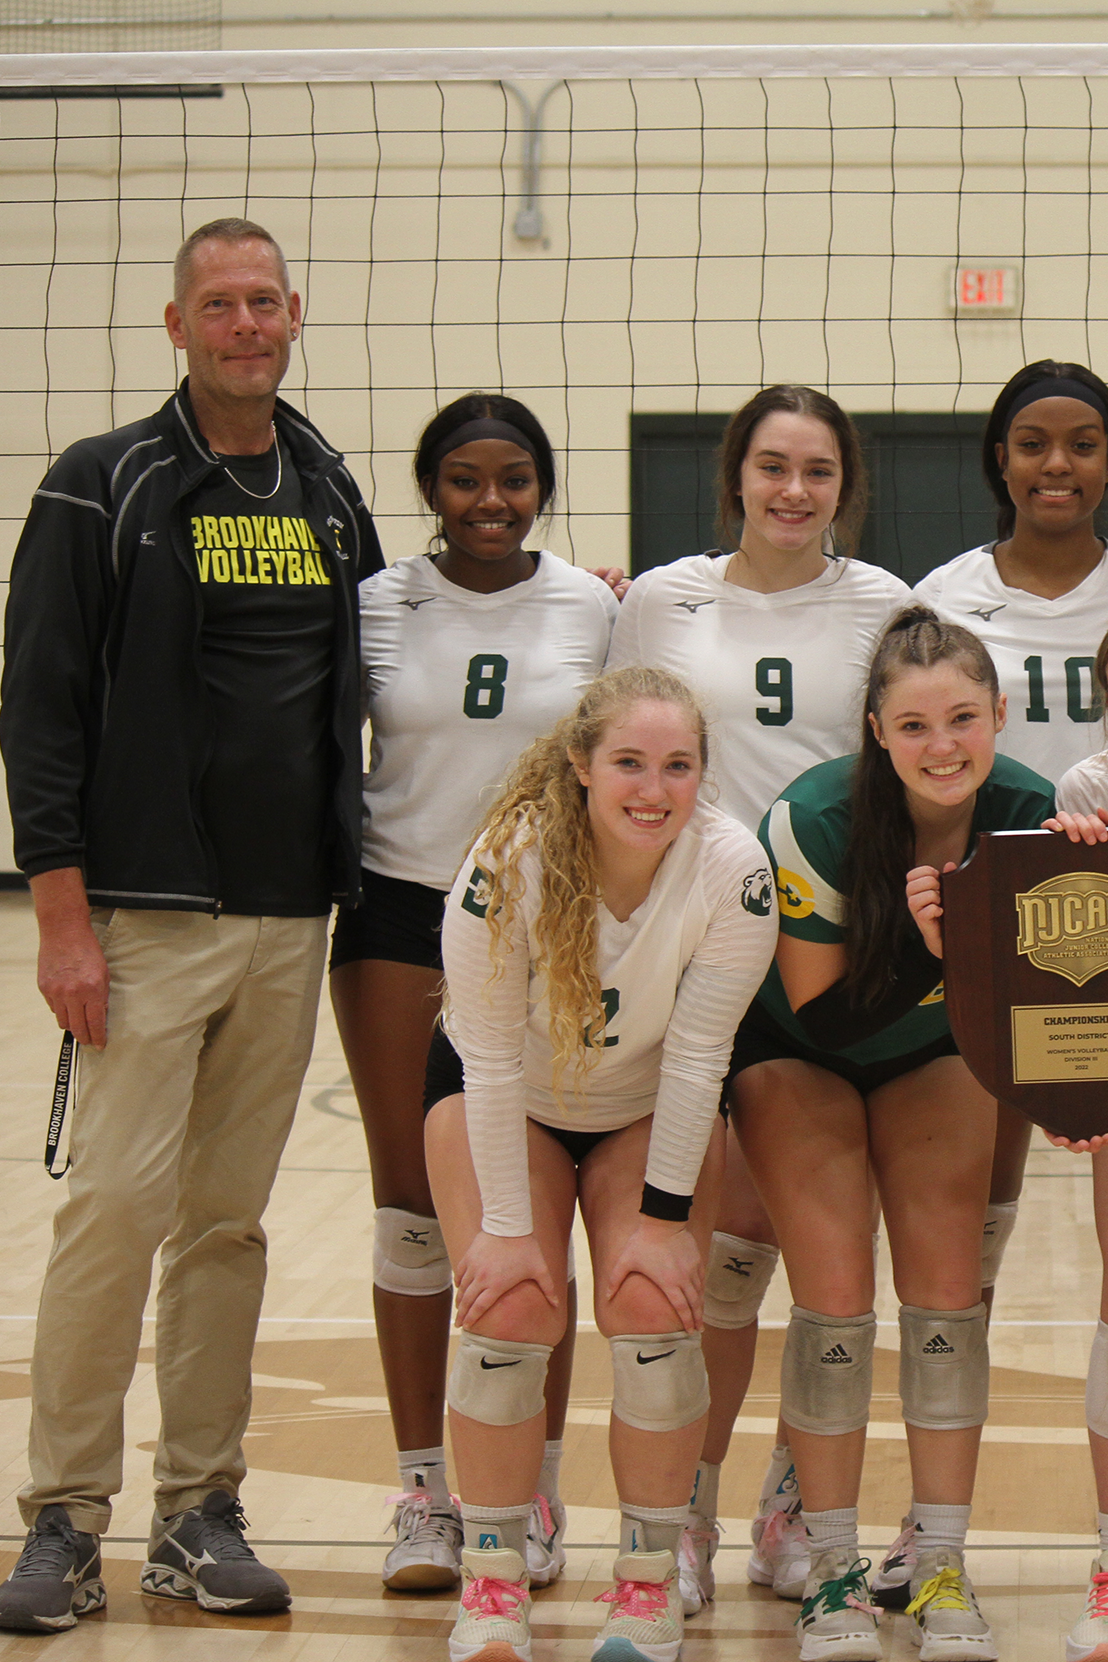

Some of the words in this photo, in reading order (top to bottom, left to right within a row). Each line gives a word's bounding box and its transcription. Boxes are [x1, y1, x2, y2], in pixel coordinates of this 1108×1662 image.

[962, 269, 1004, 304] EXIT
[463, 653, 508, 719] 8
[755, 657, 793, 727] 9
[1024, 655, 1103, 723] 10
[1043, 951, 1075, 959] ATHLETIC
[1064, 943, 1089, 951] JUNIOR
[584, 987, 620, 1048] 2
[47, 1084, 67, 1146] BROOKHAVEN
[58, 1042, 72, 1083] COLLEGE
[820, 1356, 853, 1364] adidas
[923, 1346, 955, 1354] adidas
